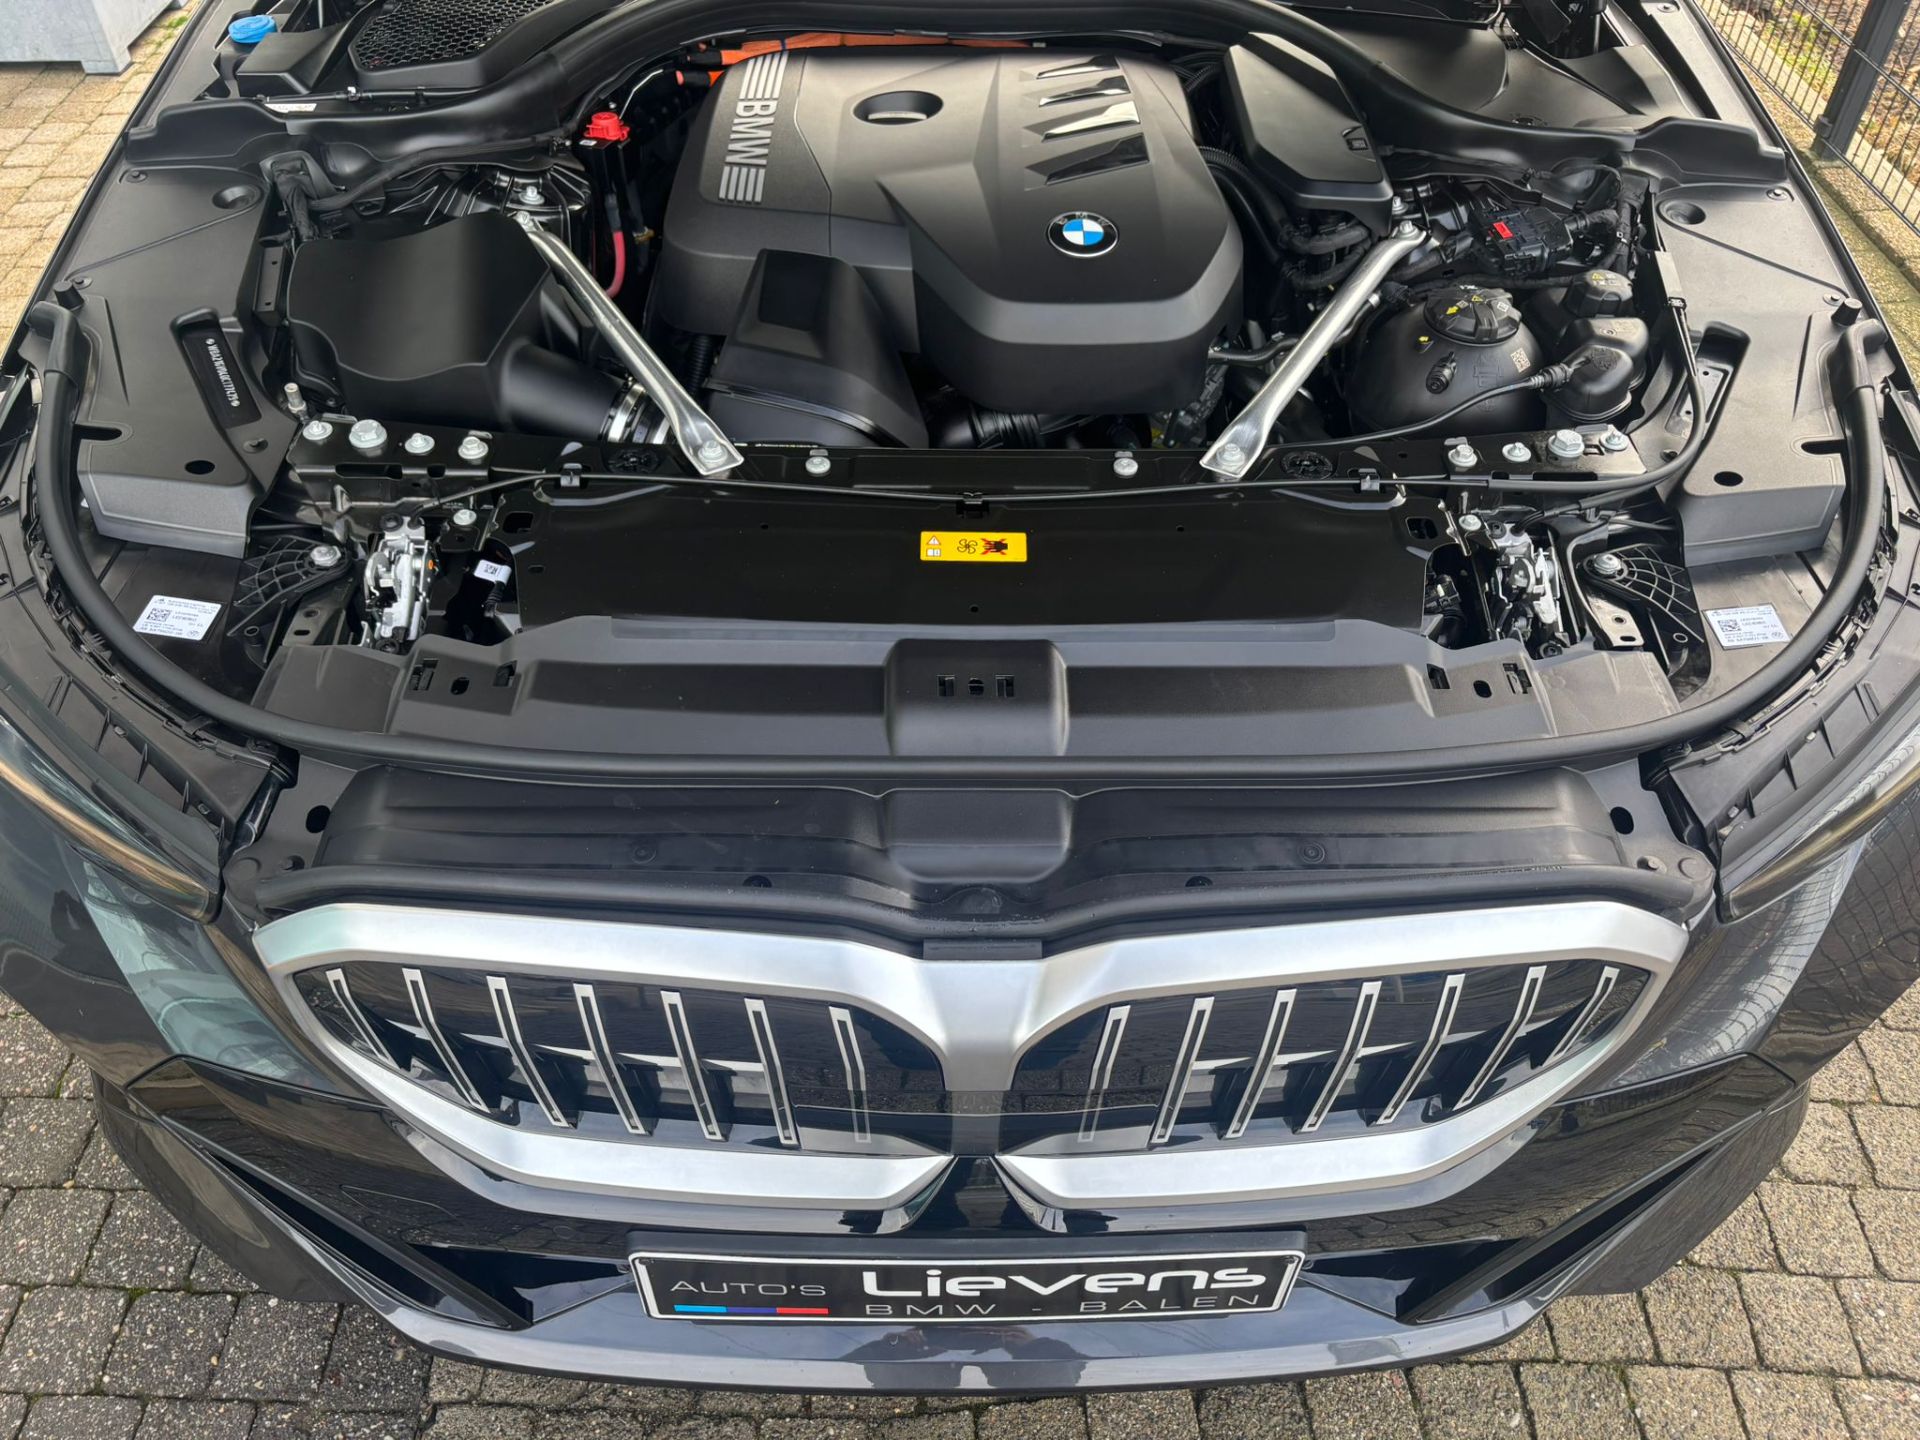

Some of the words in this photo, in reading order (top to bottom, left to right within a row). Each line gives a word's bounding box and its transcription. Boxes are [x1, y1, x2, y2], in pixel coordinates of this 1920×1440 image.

[725, 100, 778, 166] BMW
[670, 1280, 827, 1297] AUTO'S
[862, 1267, 1267, 1297] Lievens
[865, 1304, 997, 1316] BMW
[1079, 1294, 1260, 1313] BALEN
